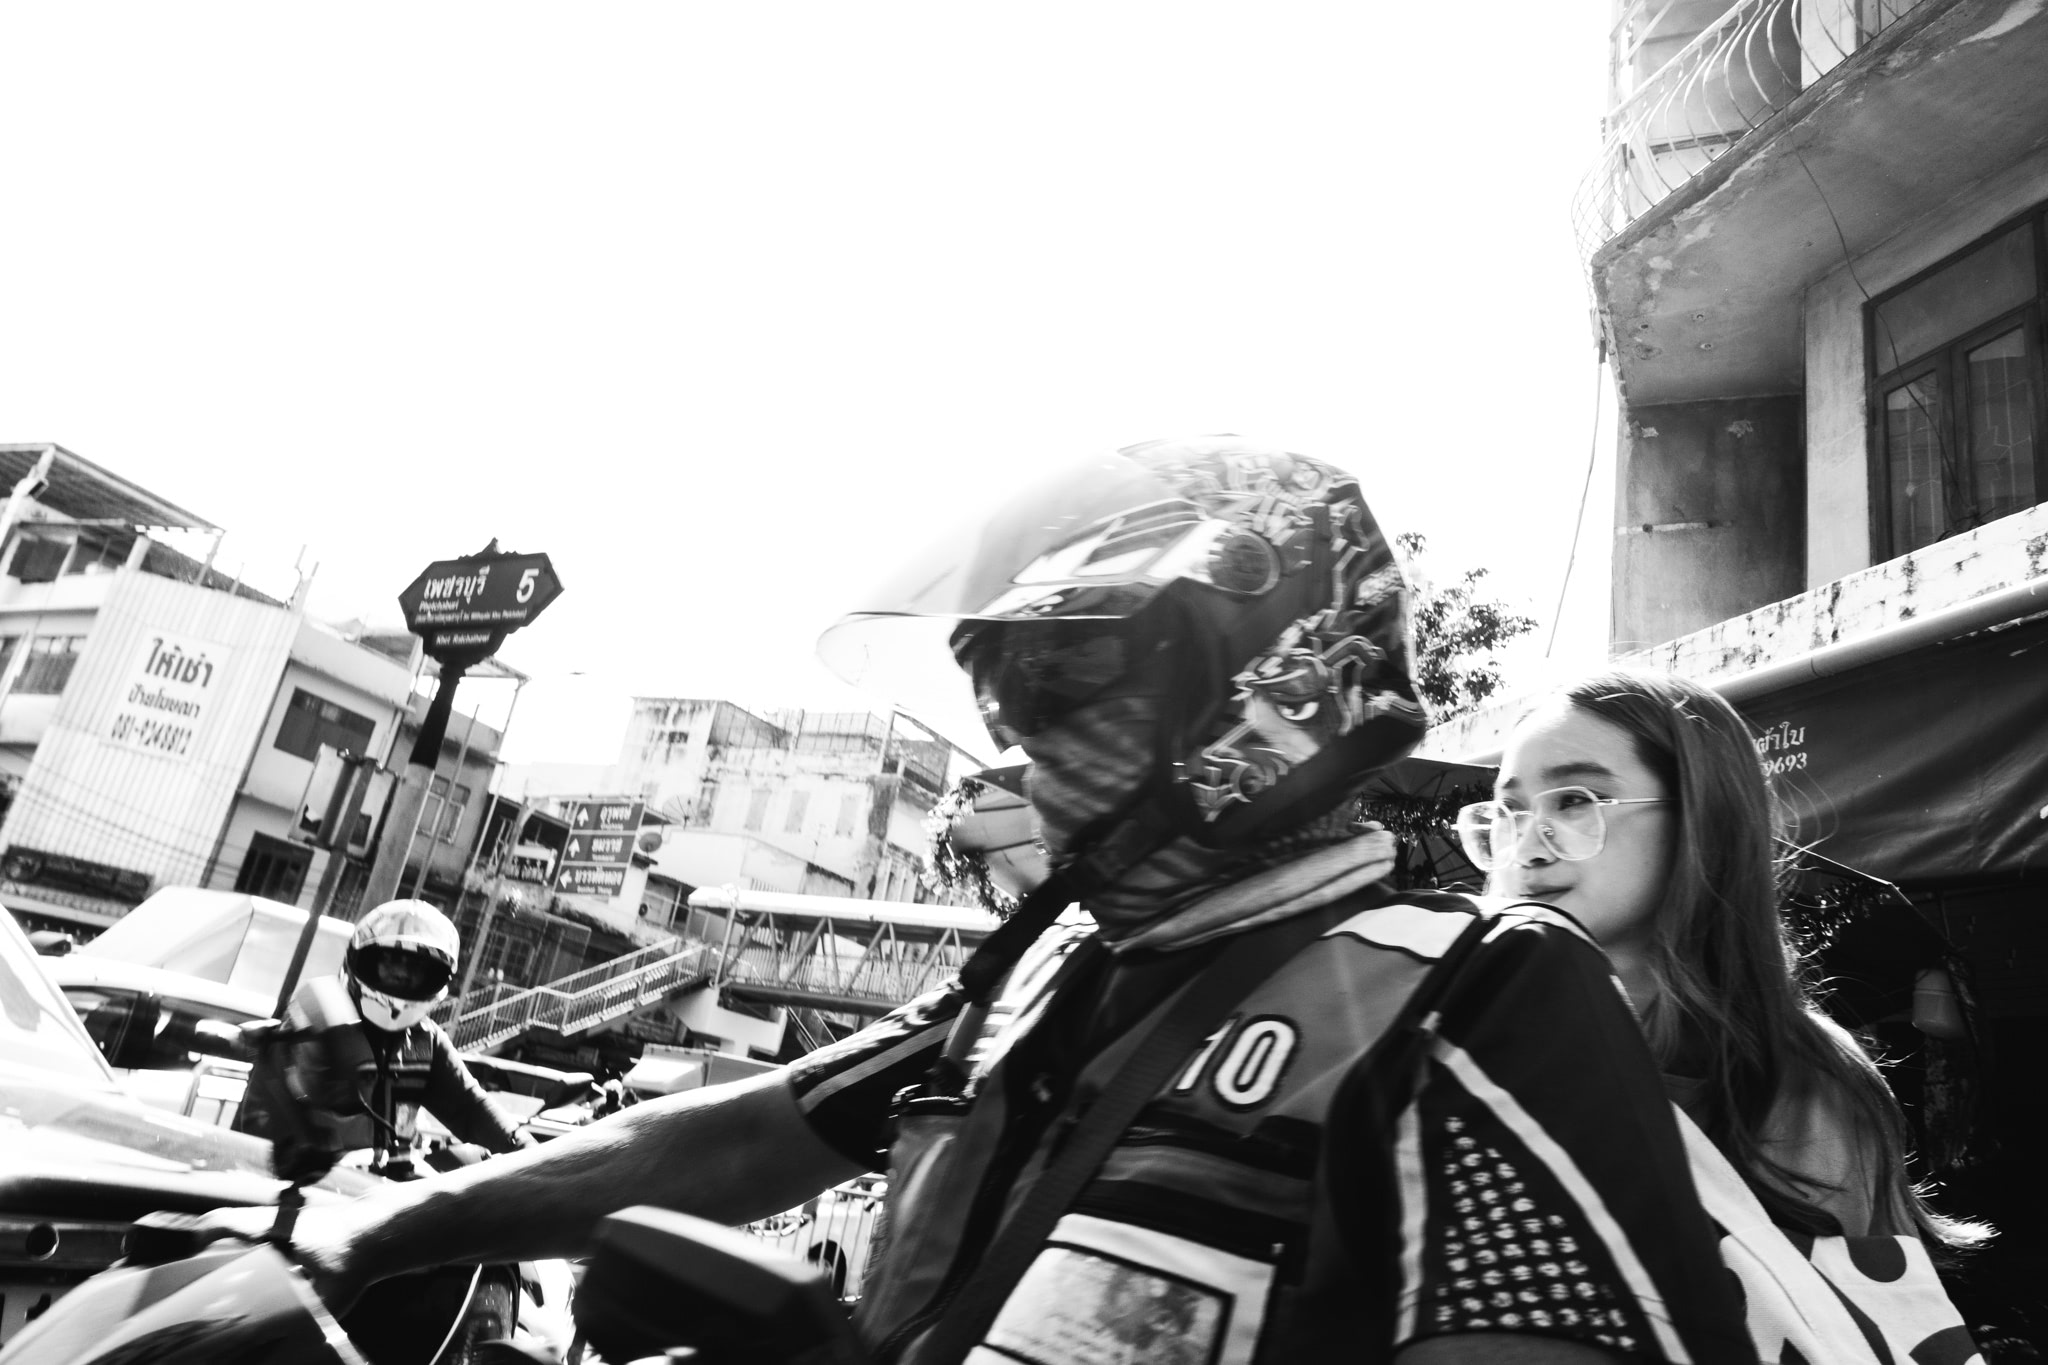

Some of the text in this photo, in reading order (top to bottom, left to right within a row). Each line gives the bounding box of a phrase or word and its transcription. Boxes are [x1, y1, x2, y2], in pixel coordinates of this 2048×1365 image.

[423, 565, 539, 604] เพชรบุรี 5
[144, 637, 213, 688] ให้เช่า
